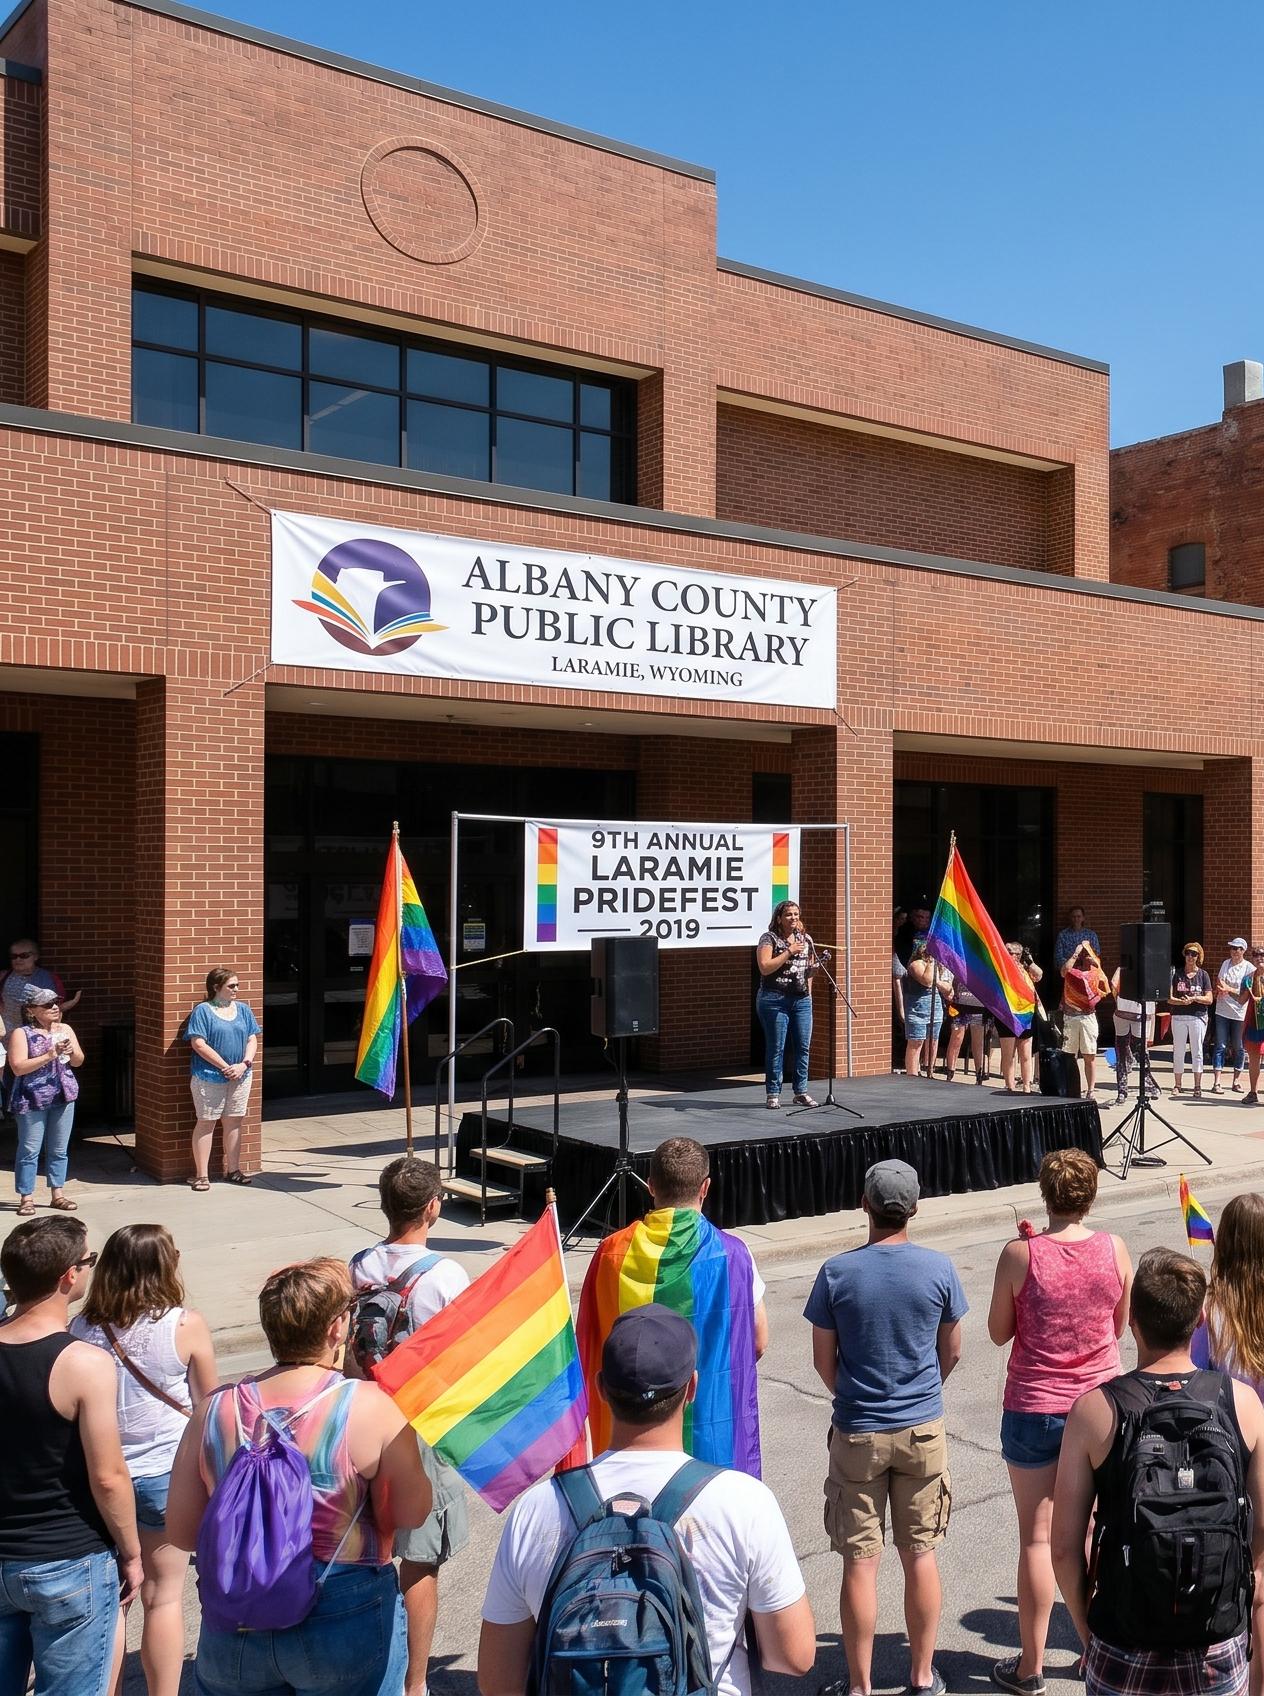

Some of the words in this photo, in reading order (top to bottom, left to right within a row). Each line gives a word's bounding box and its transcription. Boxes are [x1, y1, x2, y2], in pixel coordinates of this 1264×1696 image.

[461, 555, 641, 607] ALBANY
[651, 579, 818, 628] COUNTY
[471, 602, 635, 651] PUBLIC
[646, 621, 810, 667] LIBRARY
[551, 655, 645, 682] LARAMIE,
[649, 666, 744, 688] WYOMING
[591, 830, 639, 850] 9TH
[646, 832, 744, 851] ANNUAL
[591, 855, 744, 881] LARAMIE
[573, 887, 759, 914] PRIDEFEST
[639, 918, 700, 939] 2019
